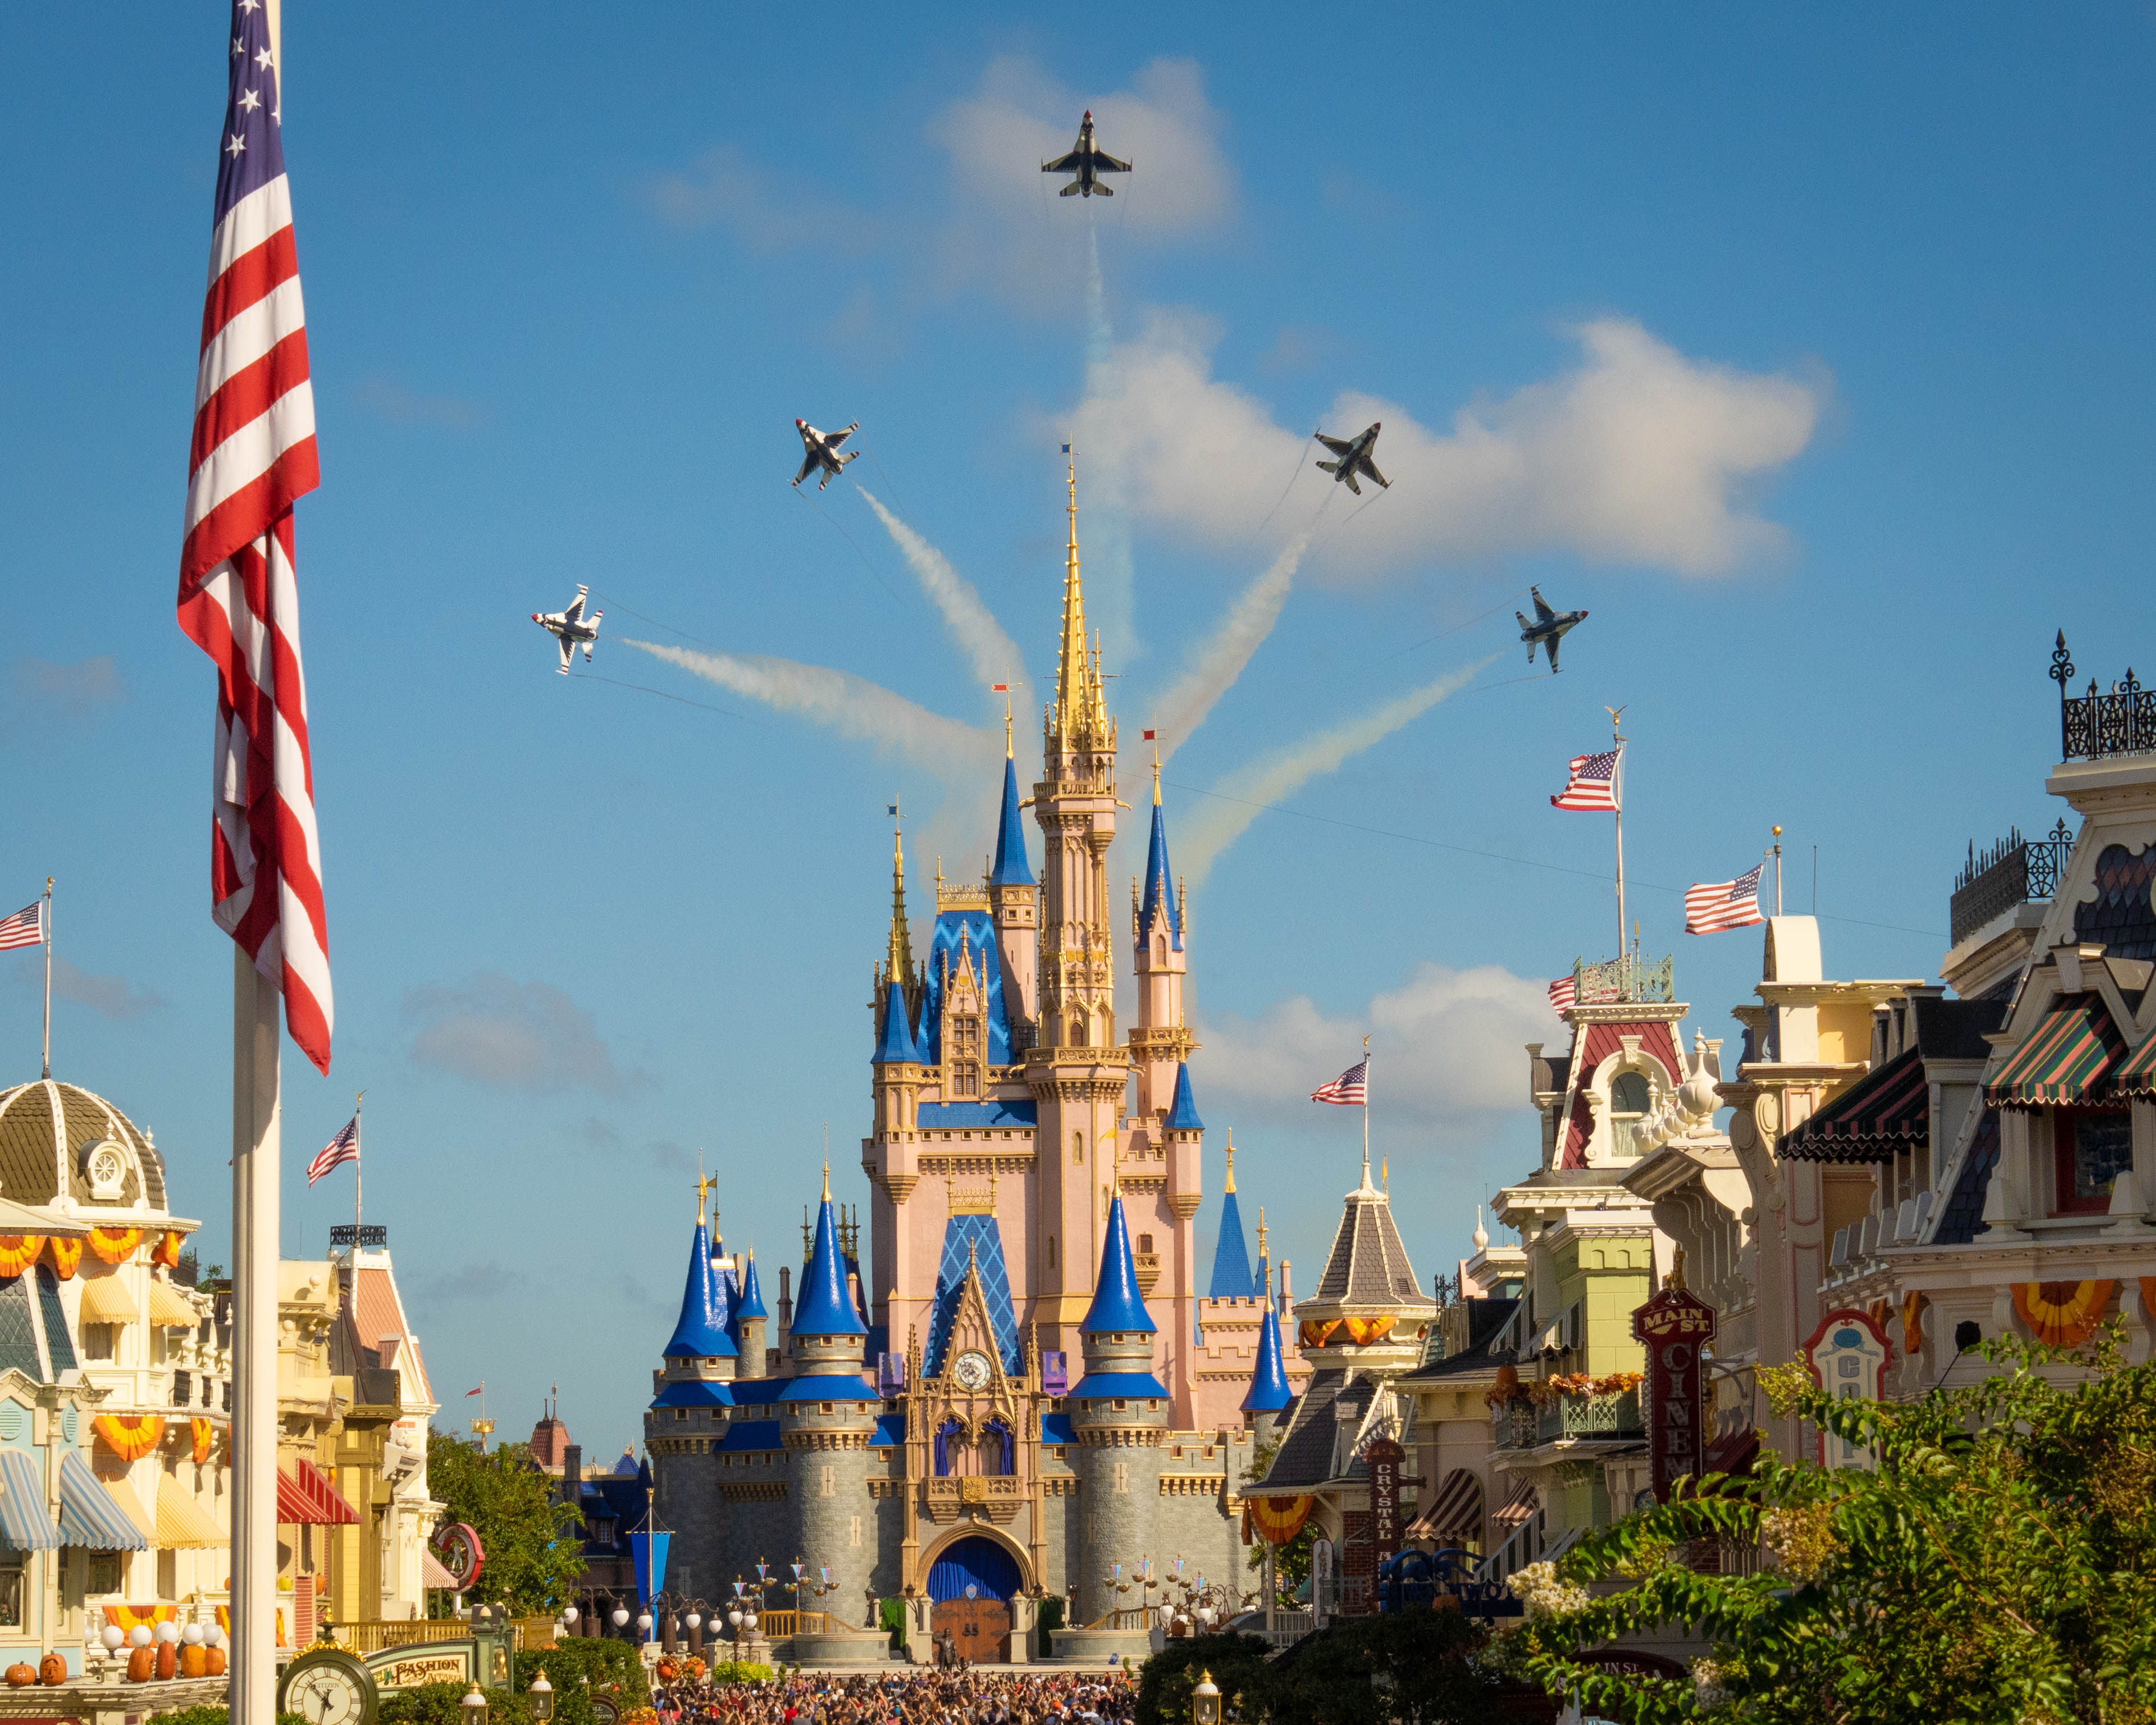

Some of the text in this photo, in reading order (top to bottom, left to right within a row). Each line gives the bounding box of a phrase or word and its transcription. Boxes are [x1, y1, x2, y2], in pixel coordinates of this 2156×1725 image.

[1643, 1309, 1703, 1330] MAIN
[1680, 1319, 1711, 1333] ST.
[1660, 1343, 1696, 1482] CINEM
[1376, 1464, 1393, 1540] CRYSTAL
[392, 1659, 461, 1685] FASHION
